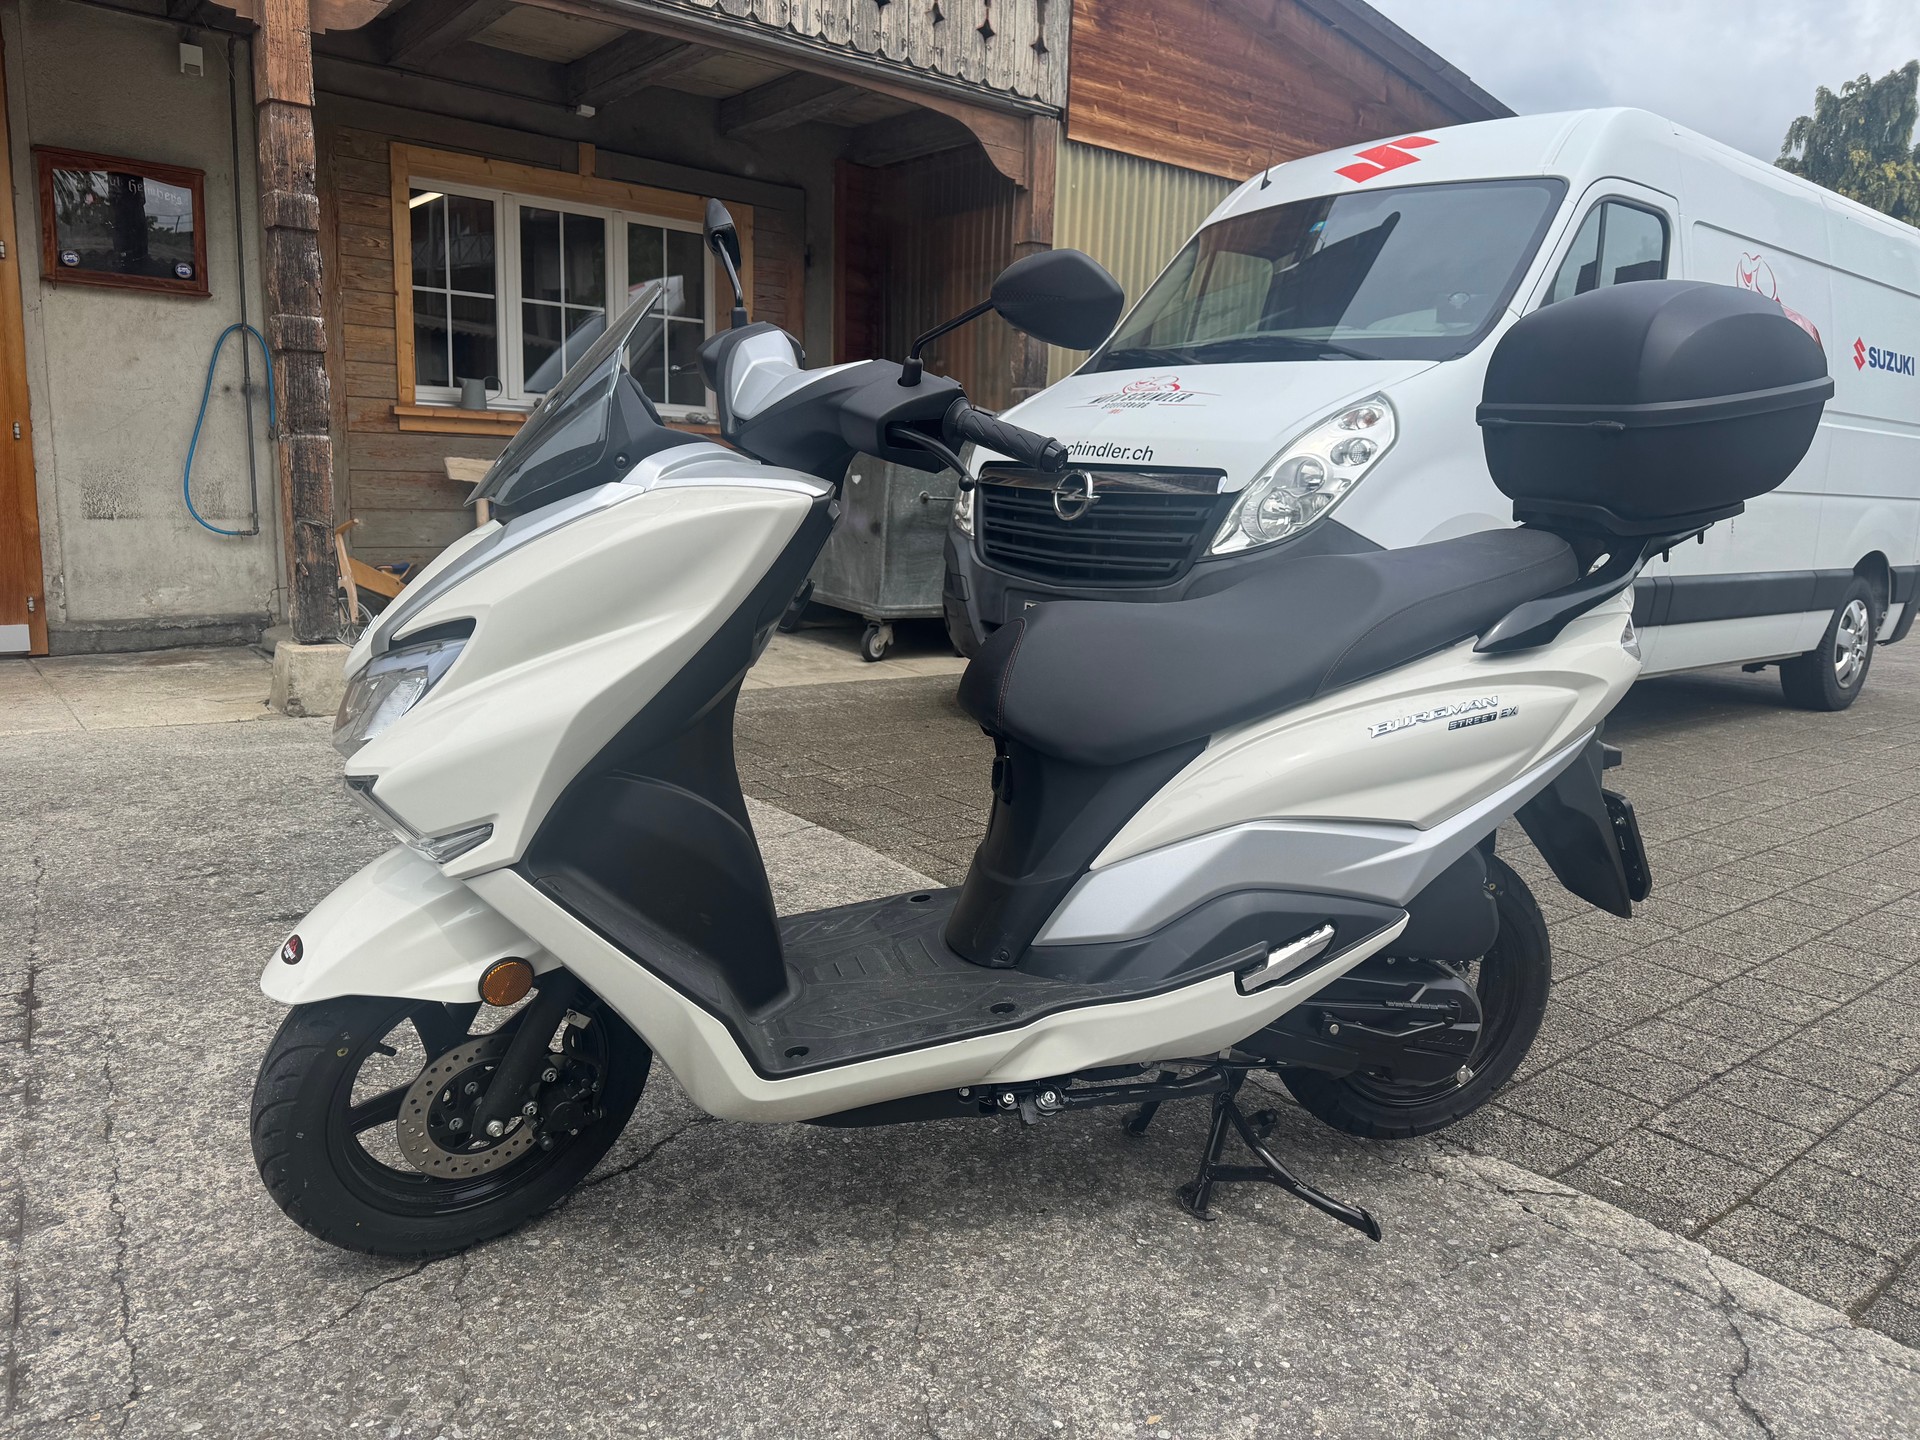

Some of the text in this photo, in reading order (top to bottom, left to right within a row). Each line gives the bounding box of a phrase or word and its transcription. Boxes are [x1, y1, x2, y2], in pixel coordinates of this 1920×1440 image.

[1868, 346, 1915, 376] SUZUKI
[1121, 391, 1195, 403] SCHINDLER
[1063, 440, 1154, 461] chindler.ch
[1368, 696, 1498, 738] BURGMAN
[1448, 706, 1518, 730] STREET EX
